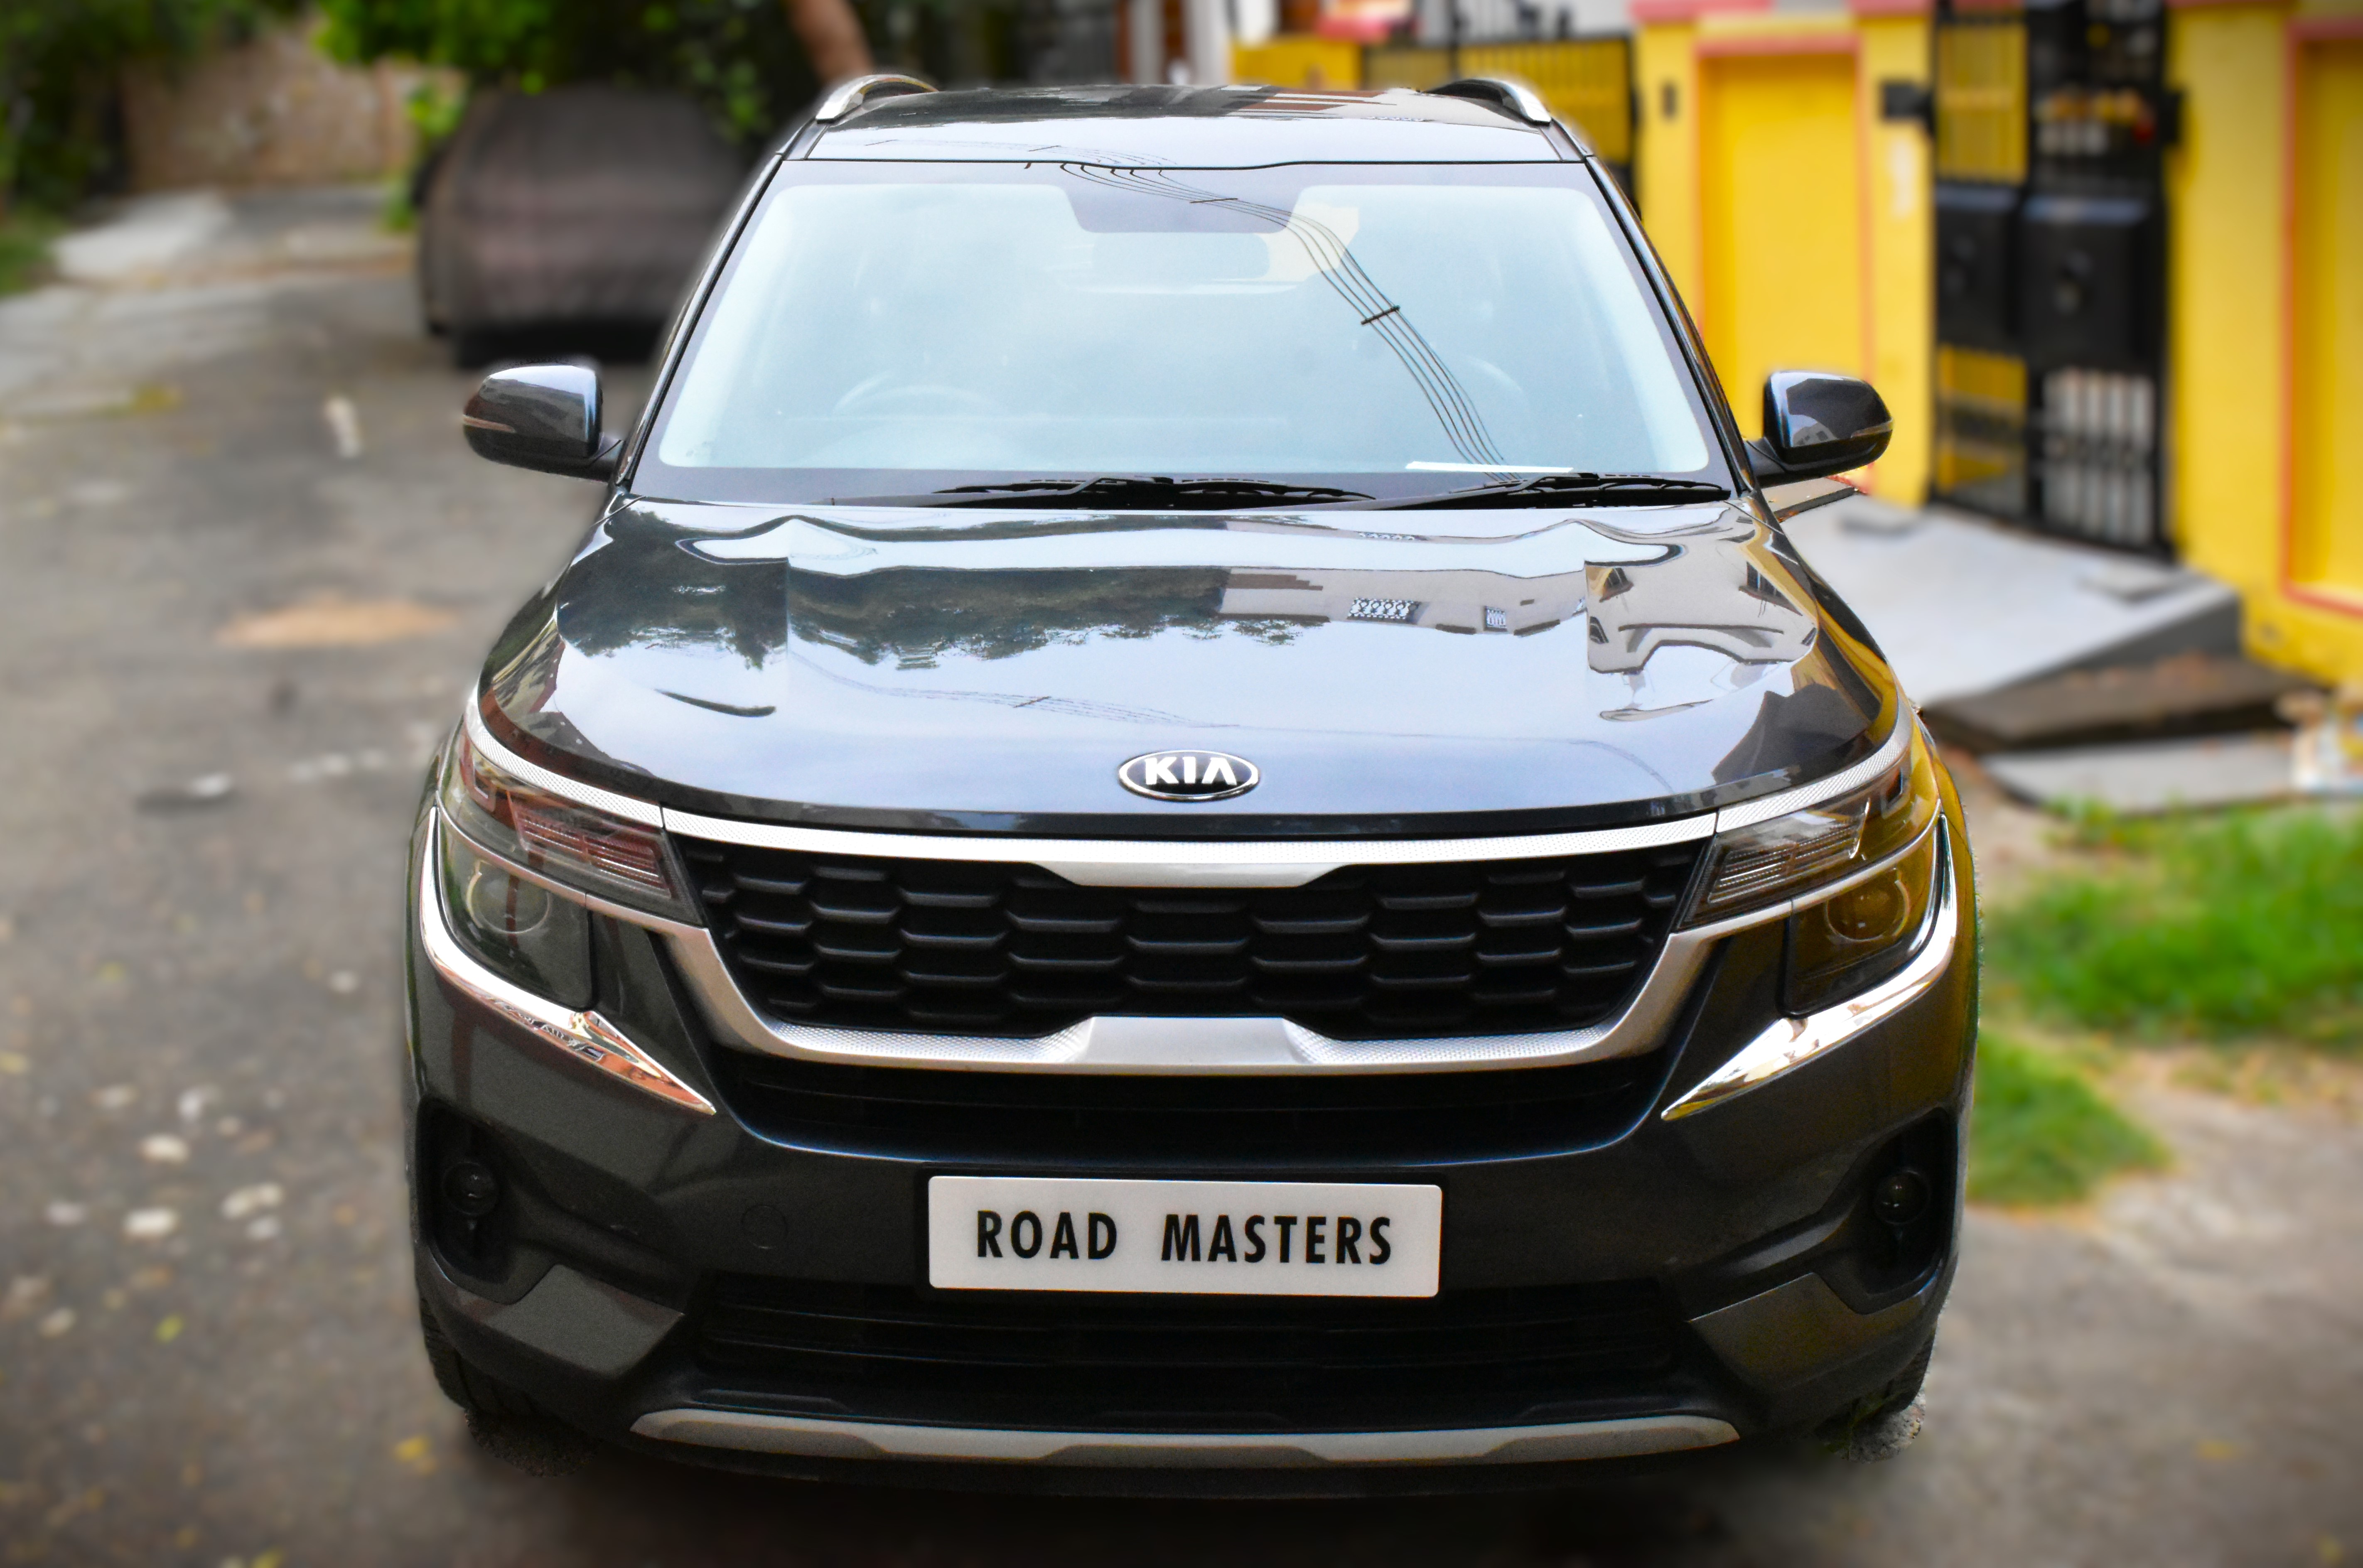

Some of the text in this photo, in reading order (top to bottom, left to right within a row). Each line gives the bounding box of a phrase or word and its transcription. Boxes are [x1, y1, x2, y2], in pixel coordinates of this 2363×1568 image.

[1145, 756, 1237, 785] KIA
[976, 1210, 1392, 1265] ROAD MASTERS
